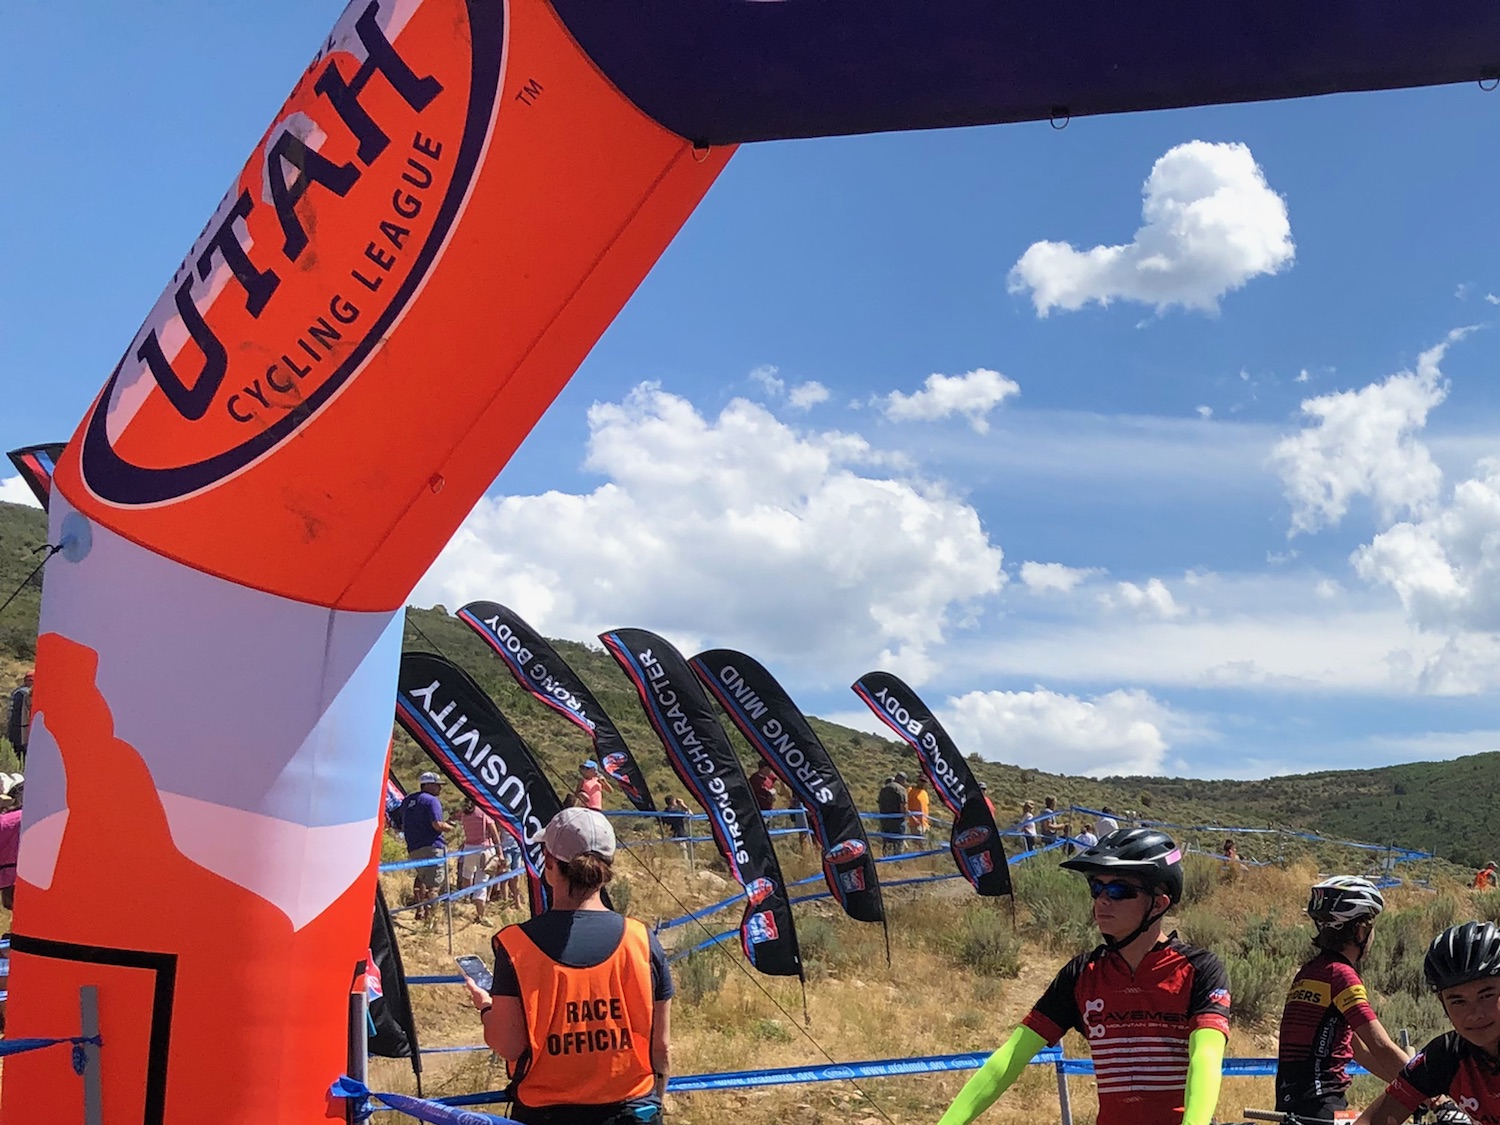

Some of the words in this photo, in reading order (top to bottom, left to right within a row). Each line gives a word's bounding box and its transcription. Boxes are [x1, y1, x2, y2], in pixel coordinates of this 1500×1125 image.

[515, 78, 543, 107] TM
[137, 0, 444, 421] UTAH
[227, 295, 359, 424] CYCLING
[351, 131, 443, 292] LEAGUE
[484, 615, 533, 666] BODY
[639, 649, 715, 774] CHARACTER
[719, 665, 769, 718] MIND
[875, 687, 923, 736] BODY
[762, 720, 834, 804] STRONG
[710, 777, 750, 865] STRONG
[566, 998, 622, 1024] RACE
[547, 1028, 633, 1056] OFFICIA
